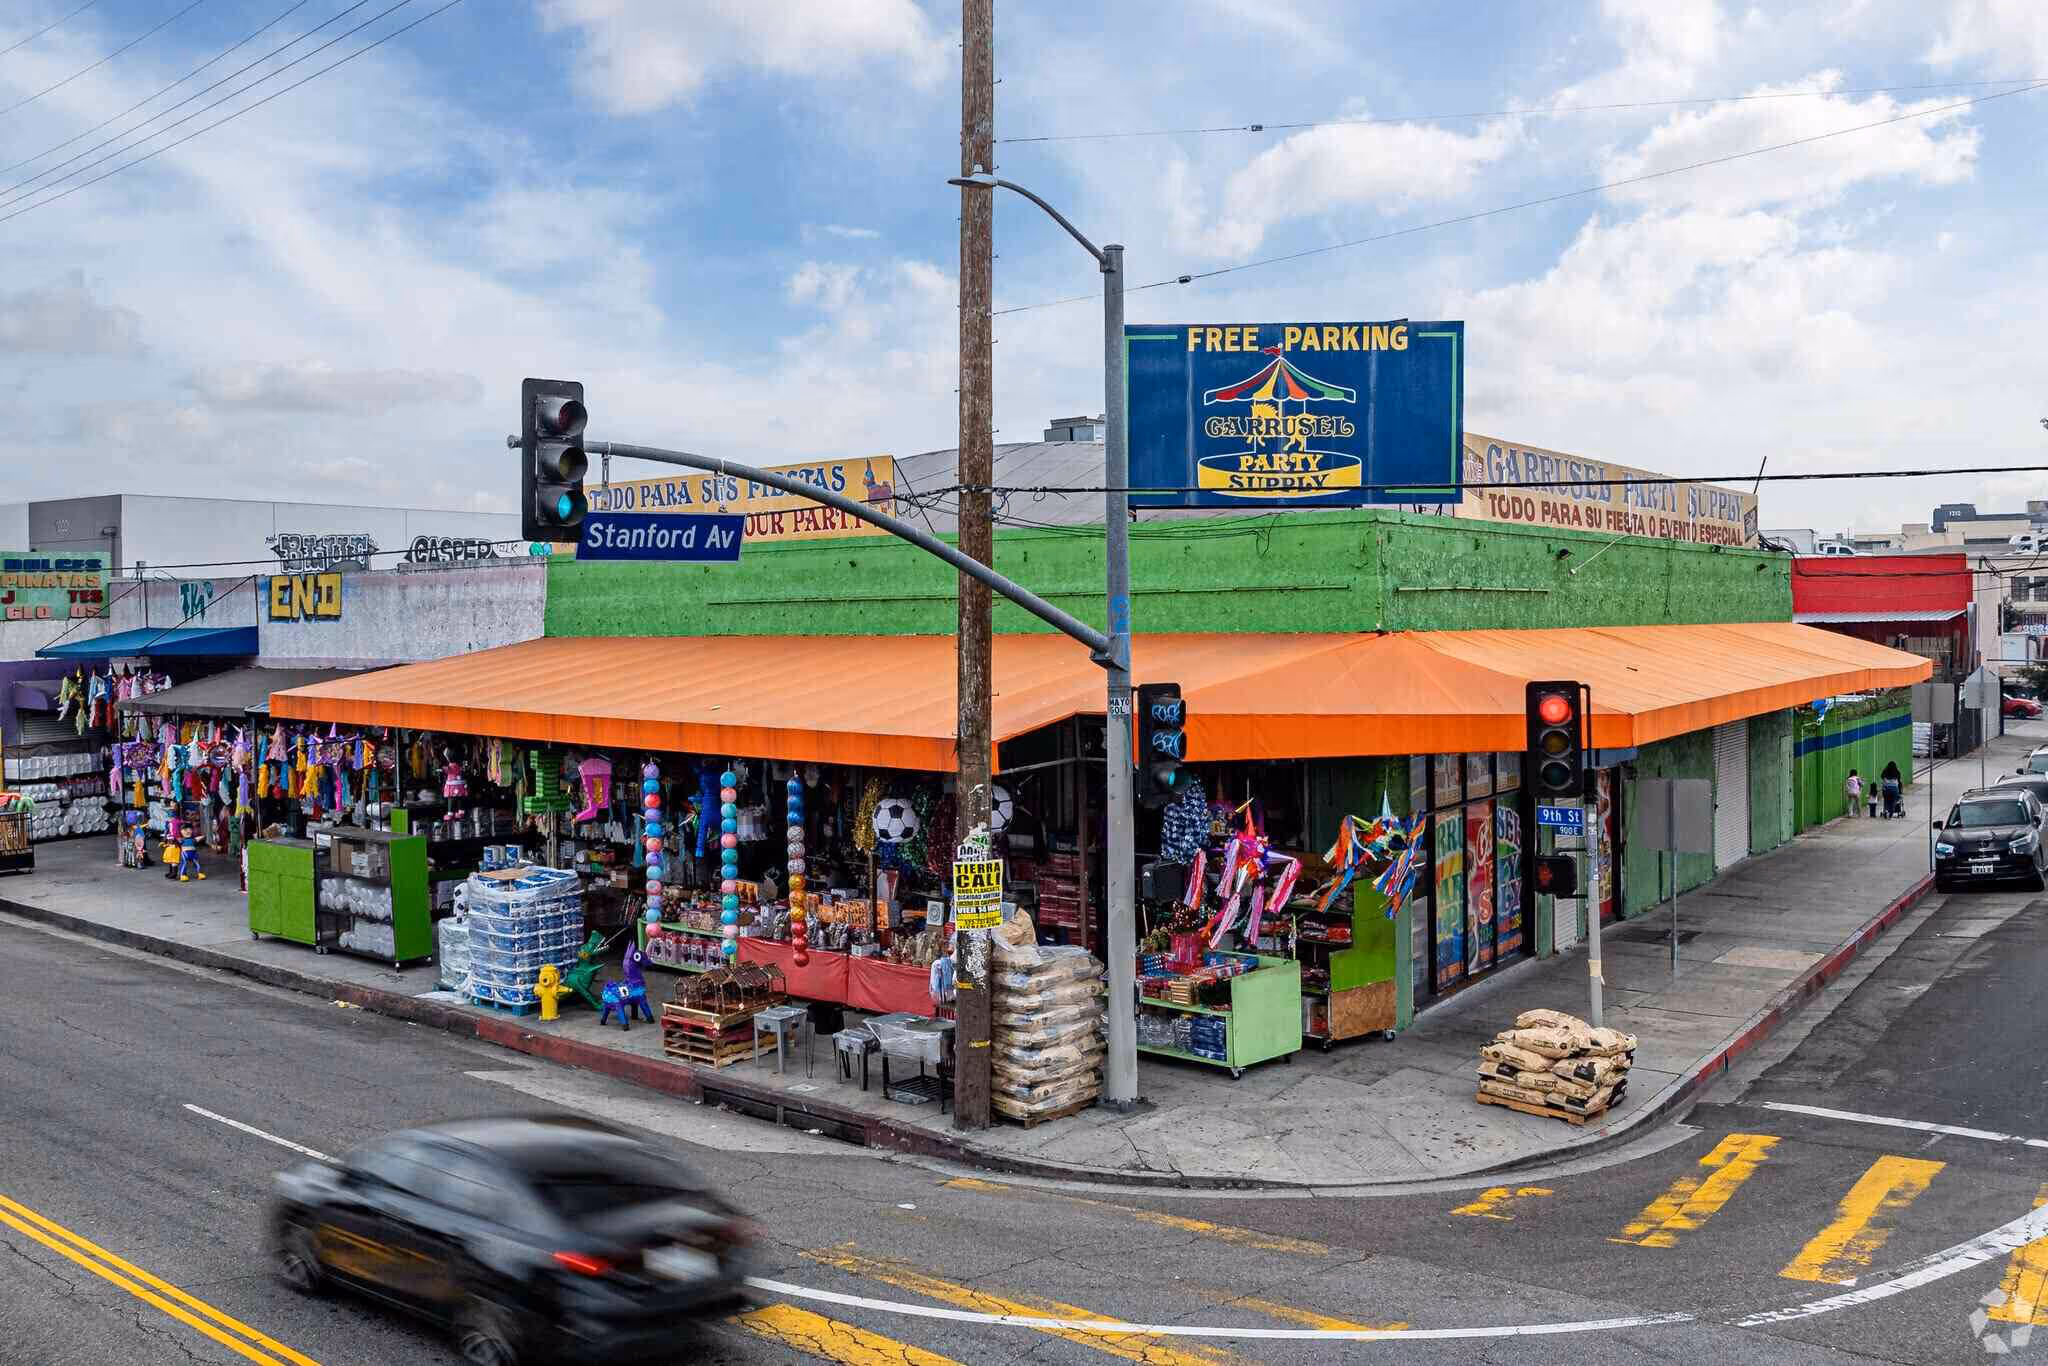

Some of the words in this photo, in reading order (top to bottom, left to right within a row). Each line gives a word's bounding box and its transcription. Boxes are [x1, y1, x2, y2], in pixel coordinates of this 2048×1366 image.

[1187, 326, 1259, 352] FREE
[1284, 325, 1409, 352] PARKING
[1238, 453, 1324, 472] PARTY
[1228, 474, 1329, 492] SUPPLY
[640, 480, 693, 508] PARA
[1488, 493, 1536, 522] TODO
[1541, 500, 1583, 527] PARA
[1585, 506, 1602, 528] SU
[1606, 510, 1646, 535] FIESTA
[1648, 515, 1657, 537] O
[1699, 523, 1743, 546] ESPECIAL
[586, 522, 697, 550] Stanford
[704, 523, 735, 550] Av
[1543, 808, 1562, 822] 9th
[1568, 810, 1580, 823] St
[954, 862, 1001, 875] TIERRA
[955, 872, 1001, 888] CALI
